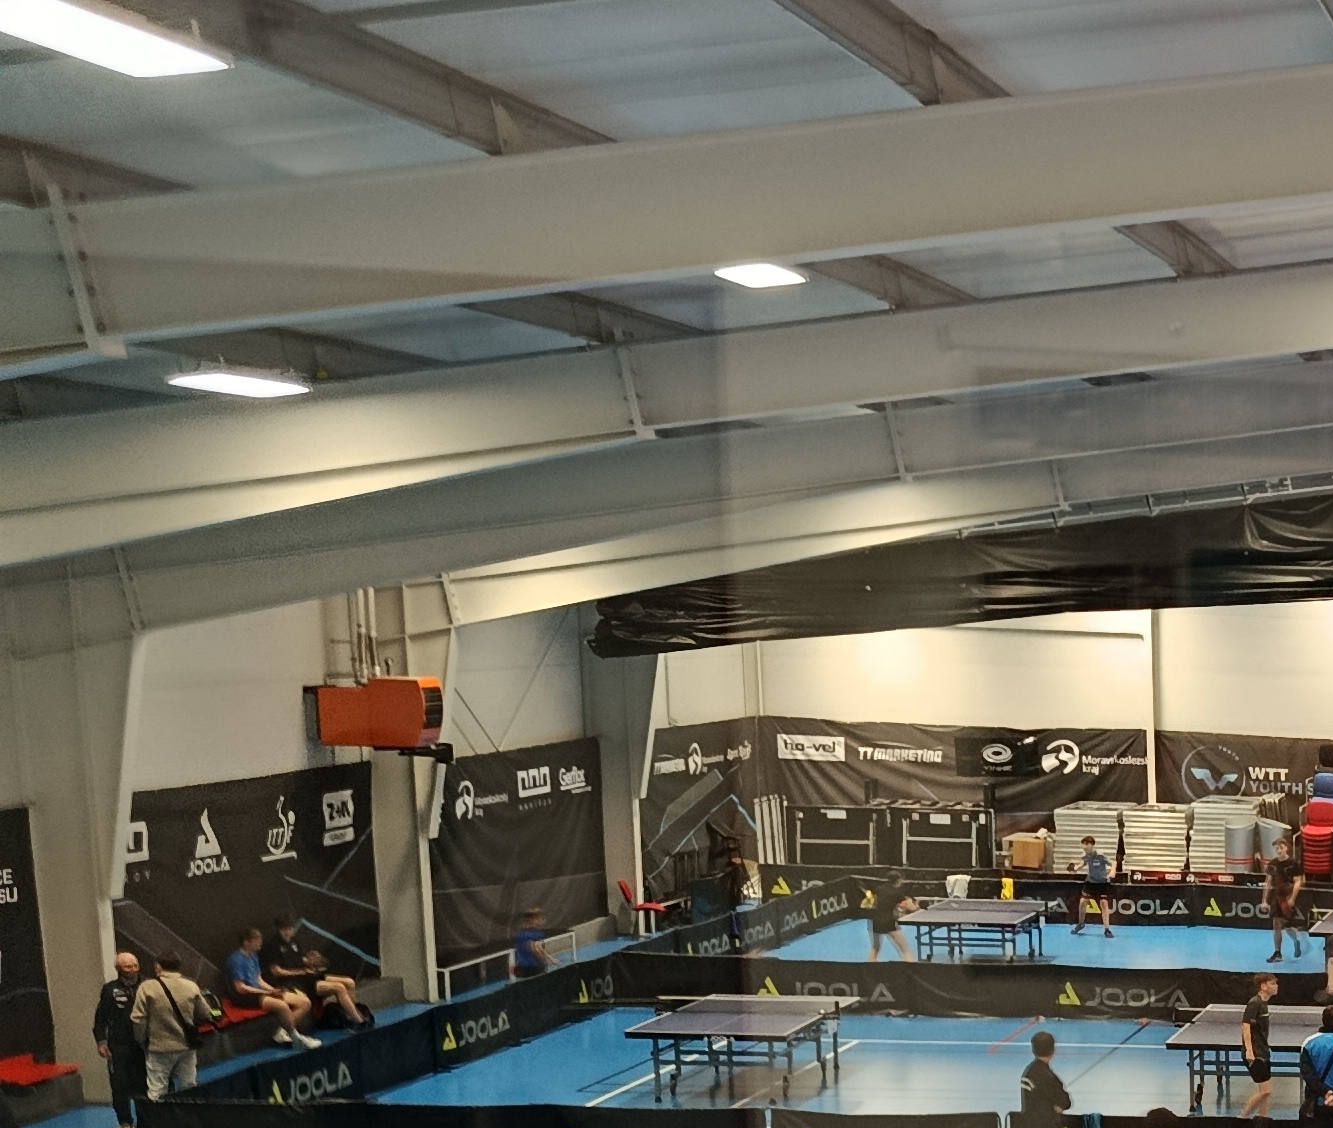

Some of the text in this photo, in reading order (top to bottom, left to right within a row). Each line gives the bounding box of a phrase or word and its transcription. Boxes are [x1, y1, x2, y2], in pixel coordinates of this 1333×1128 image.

[784, 739, 836, 753] ha-vel
[1082, 765, 1100, 776] kraj
[1248, 767, 1288, 781] WTT
[1250, 781, 1302, 795] YOUTH
[187, 856, 231, 878] JOOLA
[1108, 899, 1189, 916] JOOLA
[1087, 984, 1191, 1008] JOOLA
[460, 1008, 510, 1048] JOOLA
